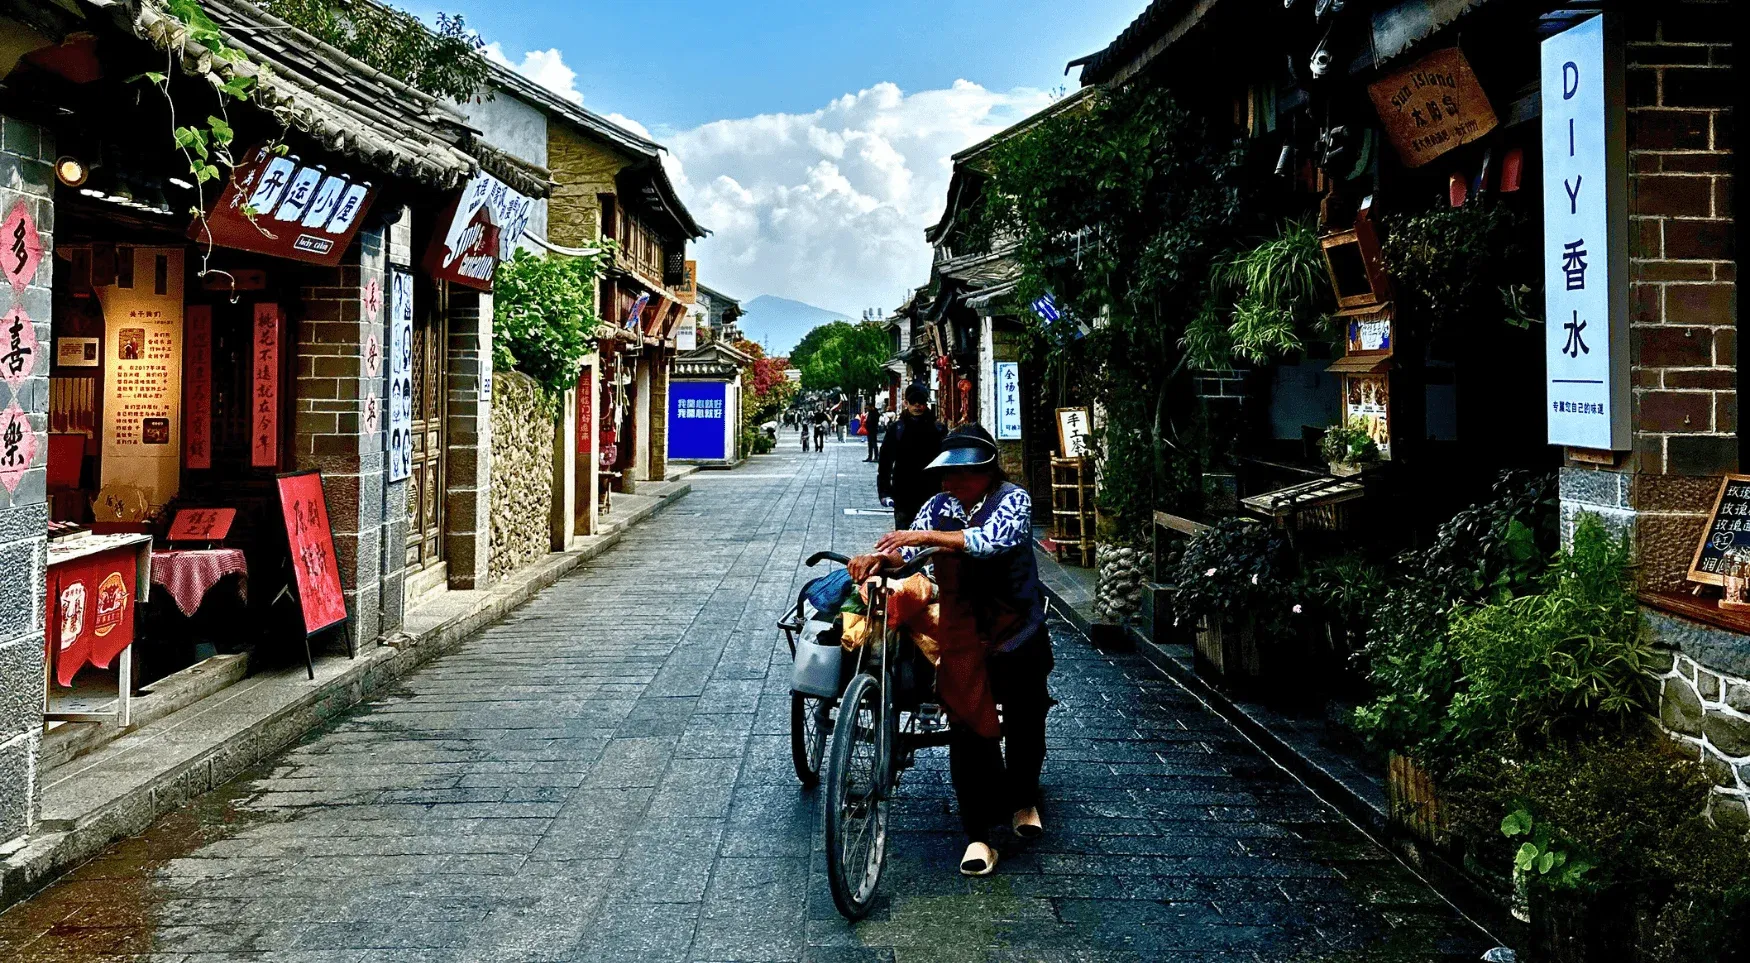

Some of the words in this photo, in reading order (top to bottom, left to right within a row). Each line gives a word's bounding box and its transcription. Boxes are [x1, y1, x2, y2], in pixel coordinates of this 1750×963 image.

[256, 170, 359, 223] 开运小屋
[1004, 368, 1017, 417] 全场耳环
